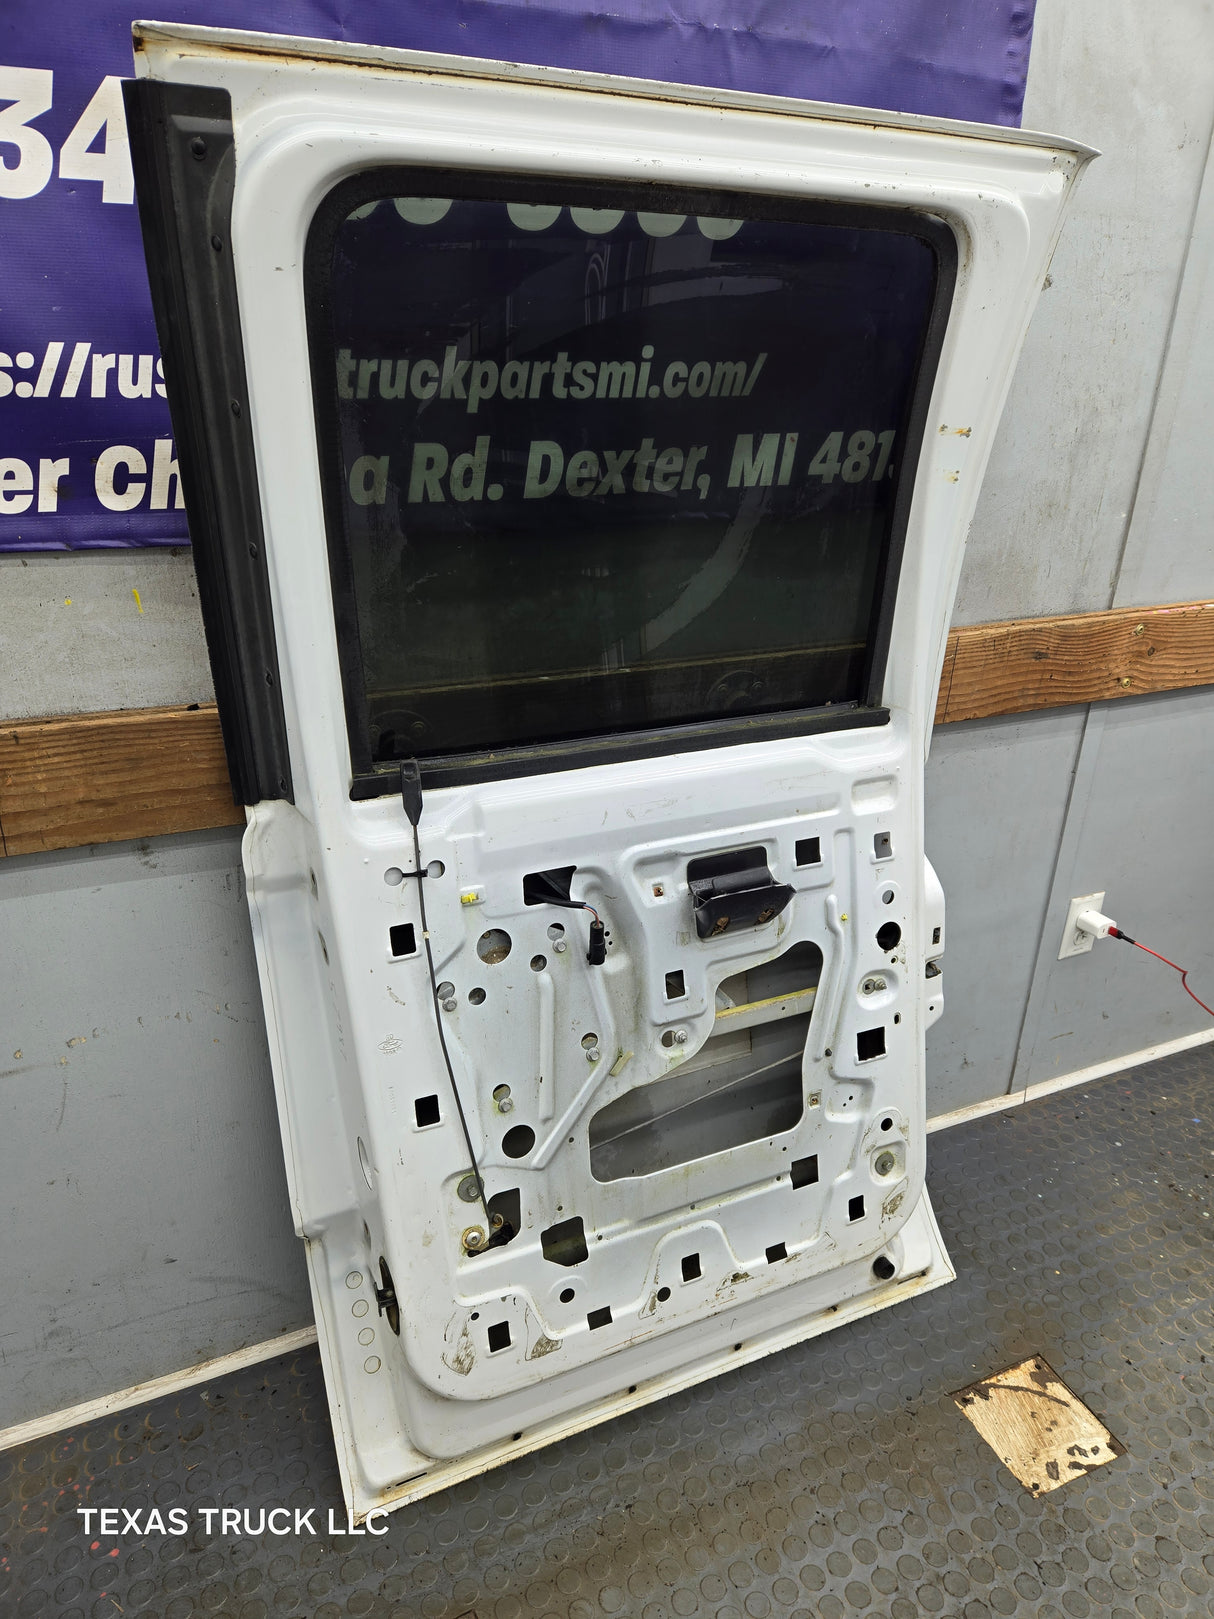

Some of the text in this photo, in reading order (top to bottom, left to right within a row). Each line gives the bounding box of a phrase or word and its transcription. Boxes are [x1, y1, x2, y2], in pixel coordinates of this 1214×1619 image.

[336, 345, 768, 413] truckpartsmi.com/
[0, 457, 70, 515] er
[350, 455, 390, 505] a
[408, 436, 504, 502] Rd.
[524, 438, 711, 499] Dexter,
[727, 432, 799, 488] MI
[808, 430, 896, 484] 481
